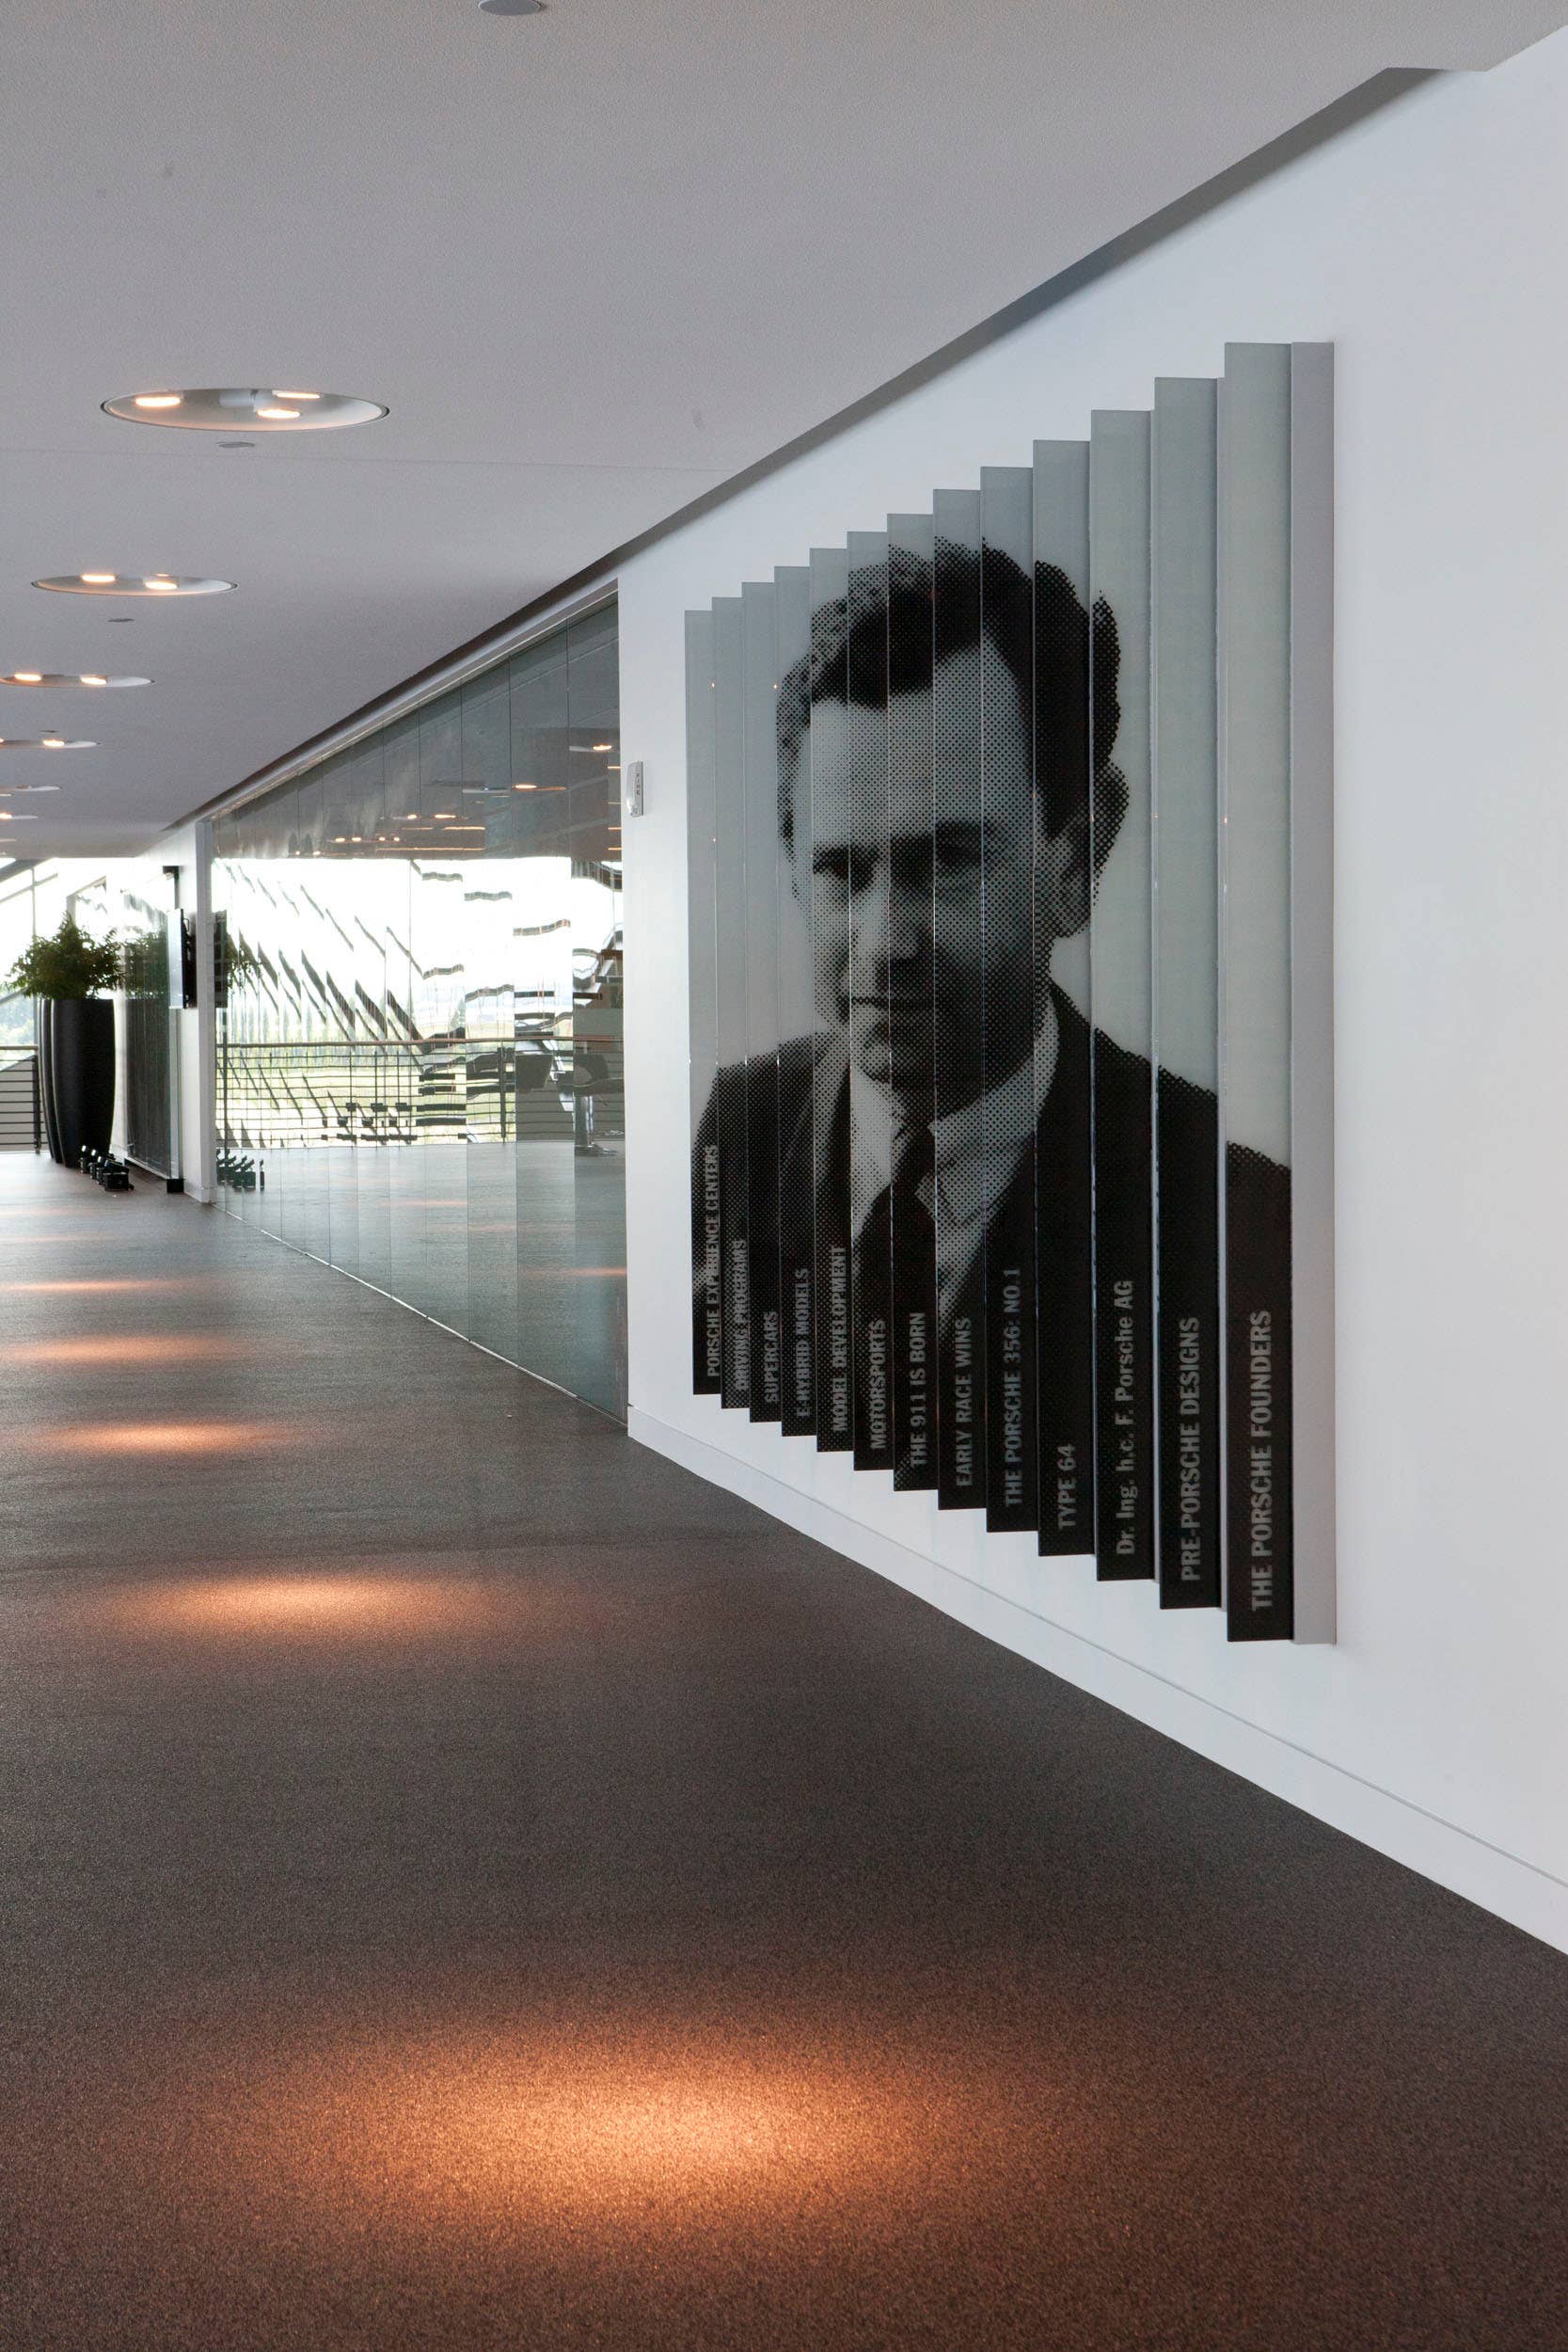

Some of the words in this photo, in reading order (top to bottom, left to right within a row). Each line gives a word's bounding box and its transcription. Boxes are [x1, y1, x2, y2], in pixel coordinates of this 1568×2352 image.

[705, 1145, 718, 1211] CENTERS
[705, 1213, 720, 1305] EXPERIENCE
[733, 1240, 749, 1325] PROGRAMS
[795, 1268, 809, 1335] MODELS
[830, 1248, 847, 1368] DEVELOPMENT
[1114, 1279, 1133, 1311] AG
[706, 1309, 720, 1376] PORSCHE
[734, 1328, 750, 1391] DRIVING
[763, 1311, 779, 1403] SUPERCARS
[909, 1312, 926, 1362] BORN
[955, 1317, 972, 1368] WINS
[1004, 1319, 1022, 1363] 356:
[1115, 1316, 1134, 1402] Porsche
[796, 1340, 811, 1417] E-HYBRID
[869, 1318, 886, 1449] MOTORSPORTS
[910, 1368, 927, 1386] IS
[1180, 1316, 1200, 1416] DESIGNS
[1250, 1310, 1272, 1438] FOUNDERS
[832, 1373, 847, 1431] MODEL
[911, 1392, 927, 1426] 911
[956, 1373, 973, 1422] RACE
[1005, 1369, 1022, 1463] PORSCHE
[1115, 1407, 1133, 1426] F.
[911, 1430, 927, 1468] THE
[956, 1430, 973, 1486] EARLY
[1057, 1442, 1076, 1471] 64
[1116, 1432, 1135, 1472] h.c.
[1006, 1469, 1022, 1507] THE
[1058, 1476, 1077, 1531] TYPE
[1116, 1479, 1138, 1519] Ing.
[1180, 1422, 1201, 1581] PRE-PORSCHE
[1250, 1445, 1272, 1557] PORSCHE
[1116, 1526, 1135, 1555] Dr.
[1251, 1563, 1273, 1612] THE
